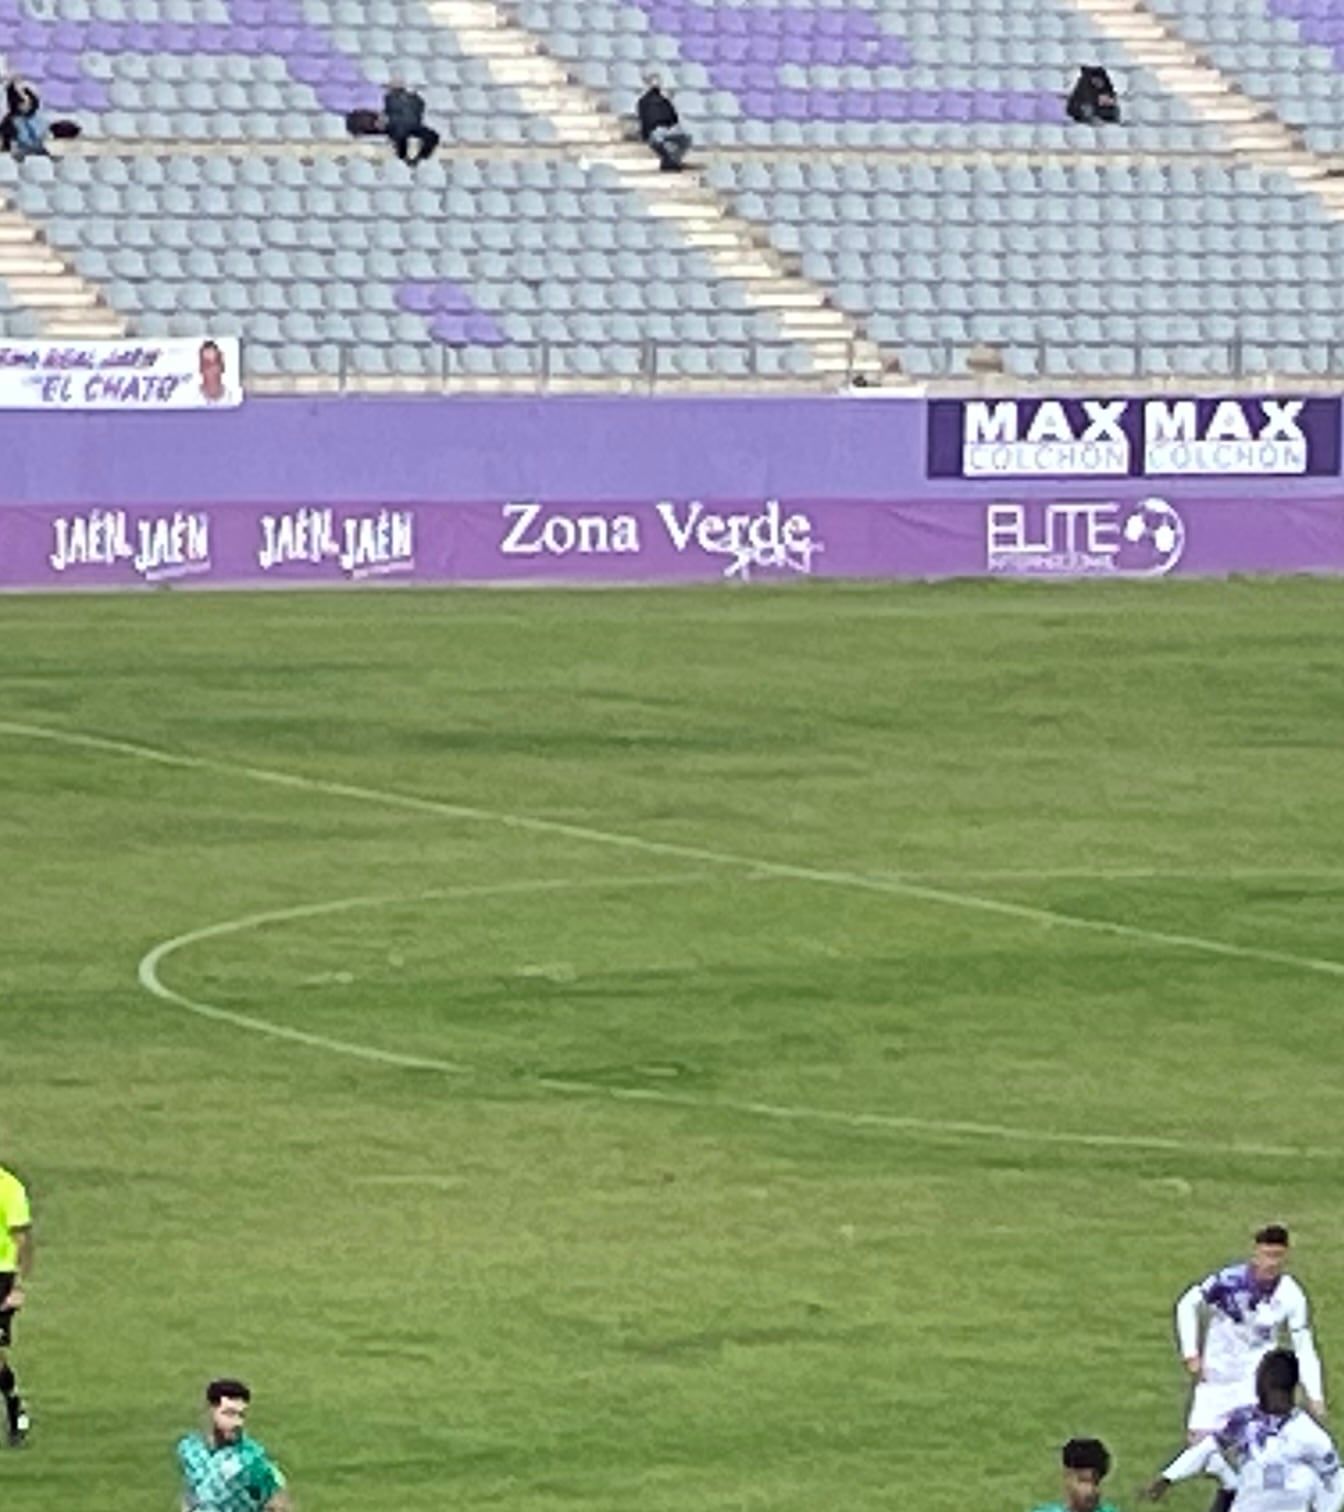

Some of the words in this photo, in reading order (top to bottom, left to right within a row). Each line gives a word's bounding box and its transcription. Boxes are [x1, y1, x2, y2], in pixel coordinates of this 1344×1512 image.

[965, 400, 1127, 441] MAX
[1145, 400, 1304, 441] MAX
[501, 502, 641, 553] Zona
[656, 499, 812, 555] Verde
[987, 503, 1121, 553] ELITE
